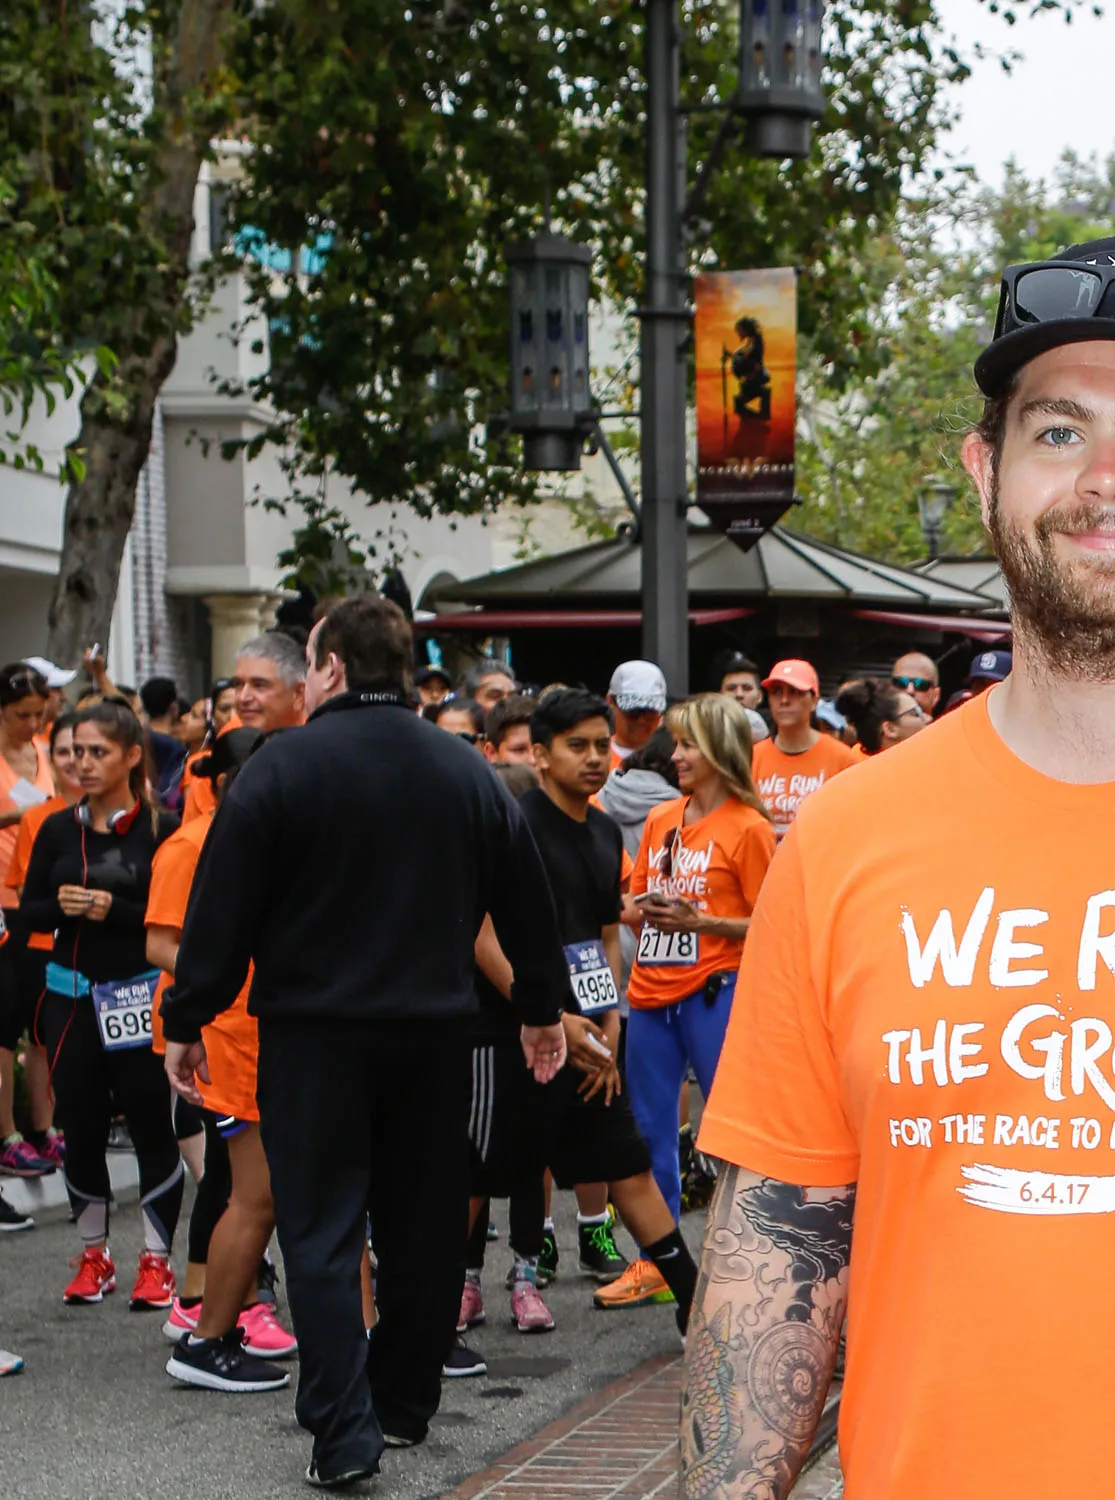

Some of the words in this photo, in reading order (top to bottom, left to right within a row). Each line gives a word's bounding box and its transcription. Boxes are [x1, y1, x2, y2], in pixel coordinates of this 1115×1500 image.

[759, 772, 786, 795] WE
[674, 840, 714, 875] RUN
[640, 930, 693, 957] 2778
[898, 886, 1049, 988] WE
[577, 973, 615, 1004] 4956
[105, 1009, 153, 1039] 698
[882, 1019, 989, 1086] THE
[889, 1115, 932, 1148] FOR
[939, 1114, 986, 1145] THE
[993, 1115, 1060, 1149] RACE
[1070, 1117, 1101, 1150] TO
[1019, 1181, 1090, 1206] 6.4.17
